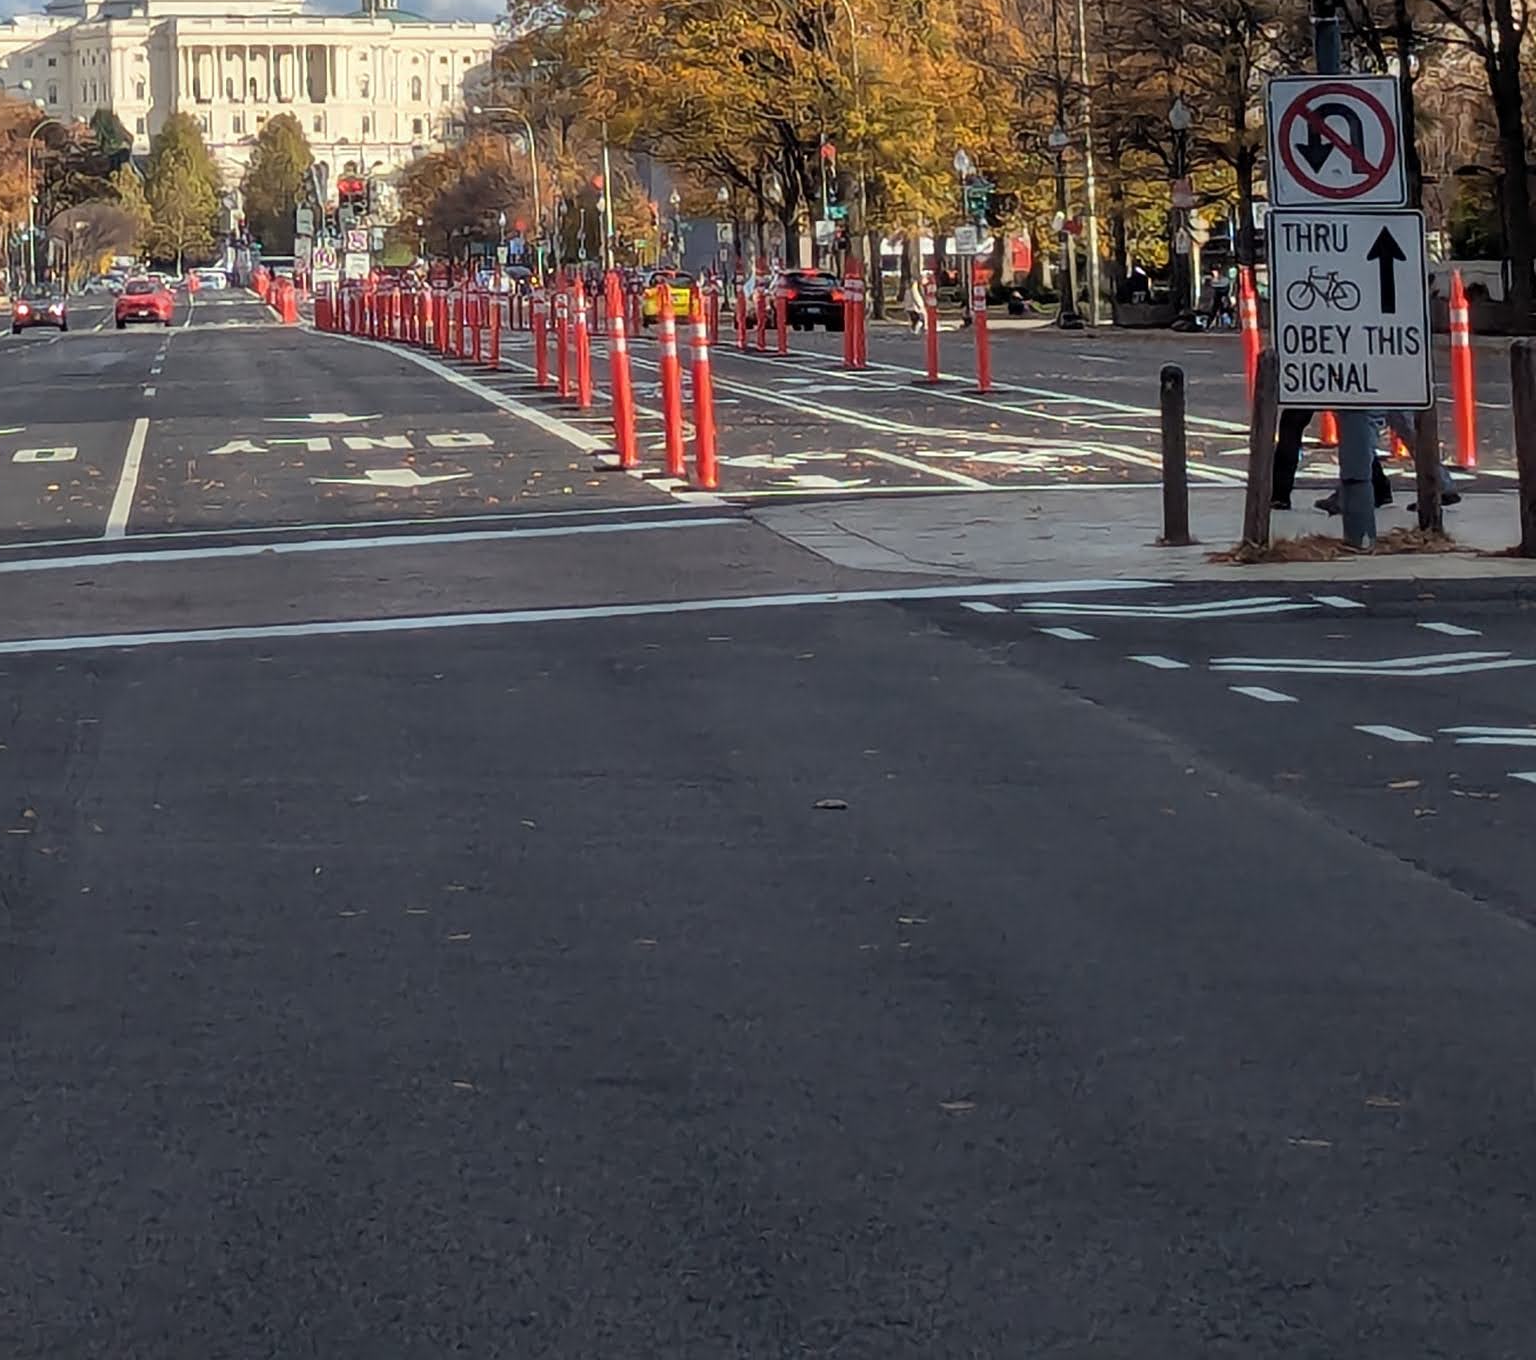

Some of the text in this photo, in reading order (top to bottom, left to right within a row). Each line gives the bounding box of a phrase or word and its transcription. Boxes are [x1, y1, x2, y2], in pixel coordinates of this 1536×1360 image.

[1281, 223, 1349, 253] THRU
[1283, 324, 1420, 355] OBEY THIS
[1284, 362, 1378, 393] SIGNAL
[208, 433, 495, 455] ONLY
